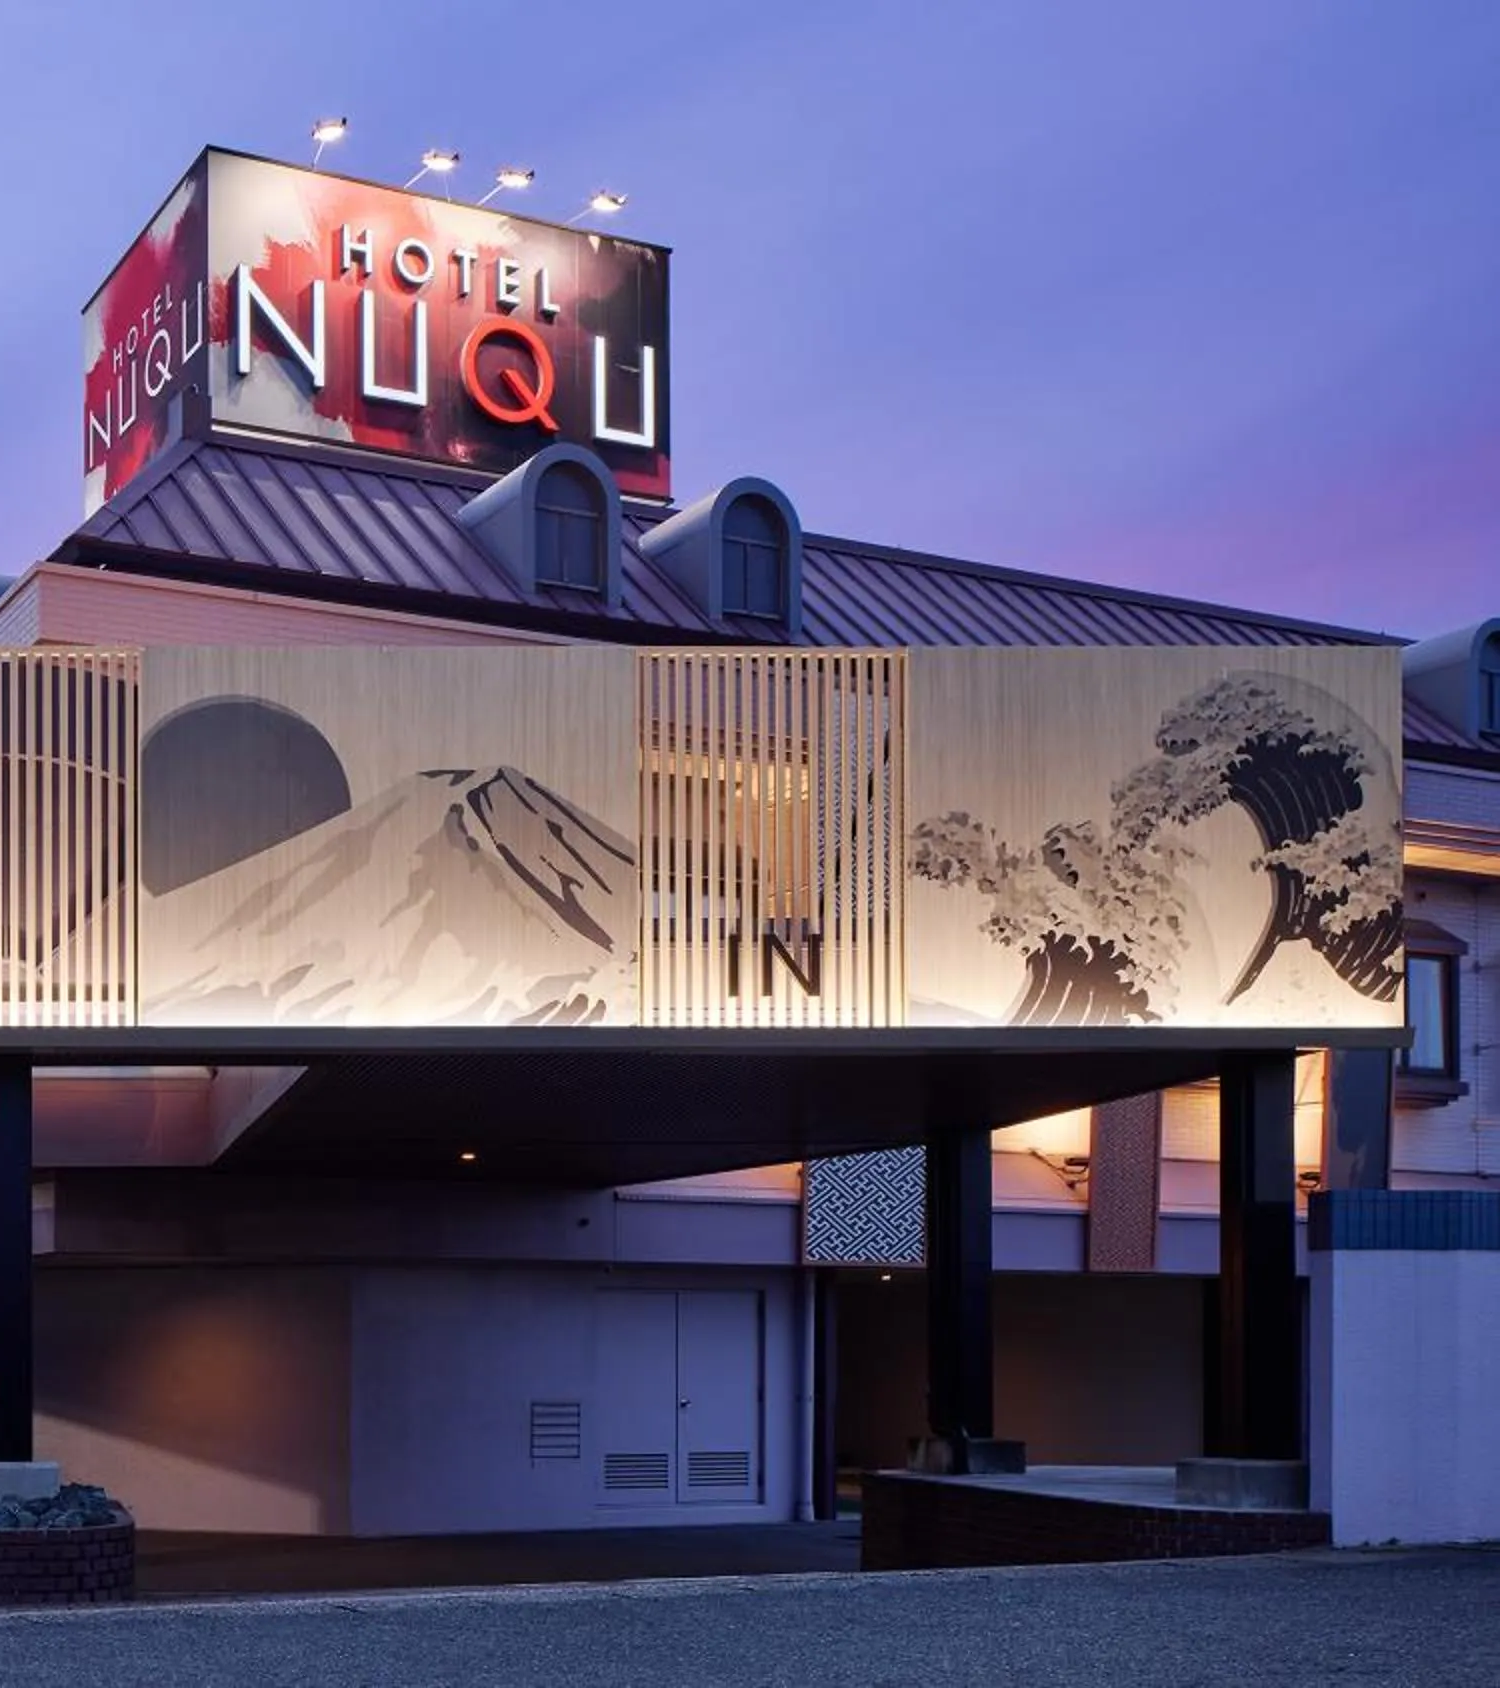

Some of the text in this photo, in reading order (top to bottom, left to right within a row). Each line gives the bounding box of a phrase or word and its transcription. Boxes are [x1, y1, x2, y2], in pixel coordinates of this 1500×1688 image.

[340, 223, 560, 317] HOTEL
[89, 280, 203, 469] NUQU
[113, 282, 173, 374] HOTEL
[236, 263, 655, 448] NUQU
[728, 933, 821, 996] IN
